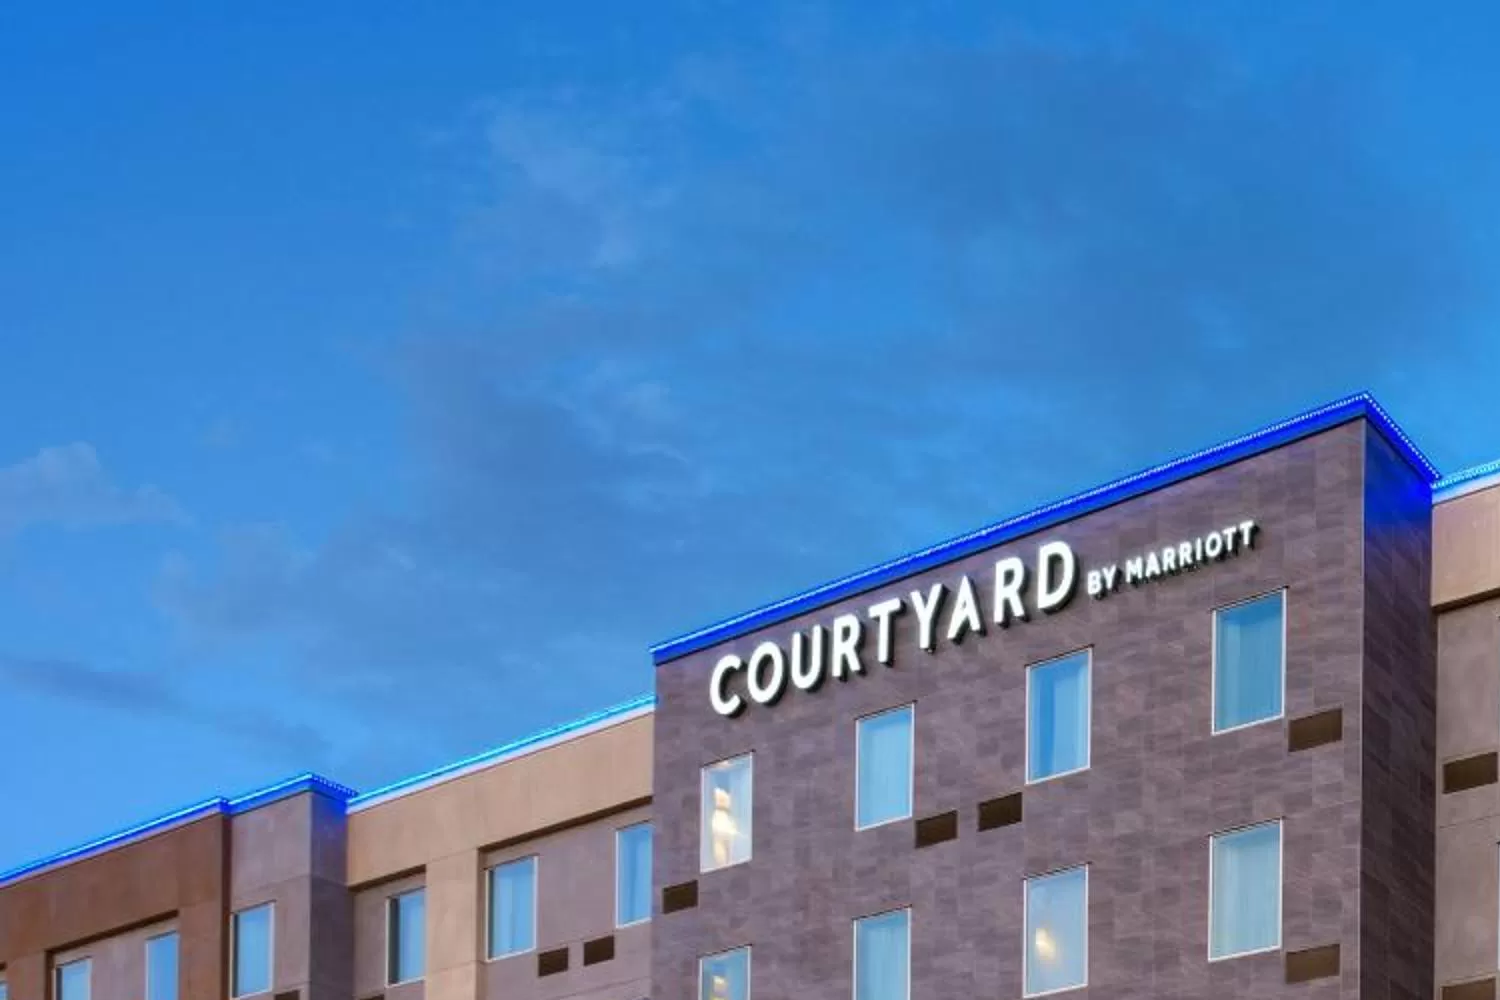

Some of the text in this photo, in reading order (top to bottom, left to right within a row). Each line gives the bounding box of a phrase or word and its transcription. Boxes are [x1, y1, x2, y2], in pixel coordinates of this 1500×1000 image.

[708, 519, 1254, 716] COURTYARD BY MARRIOTT
